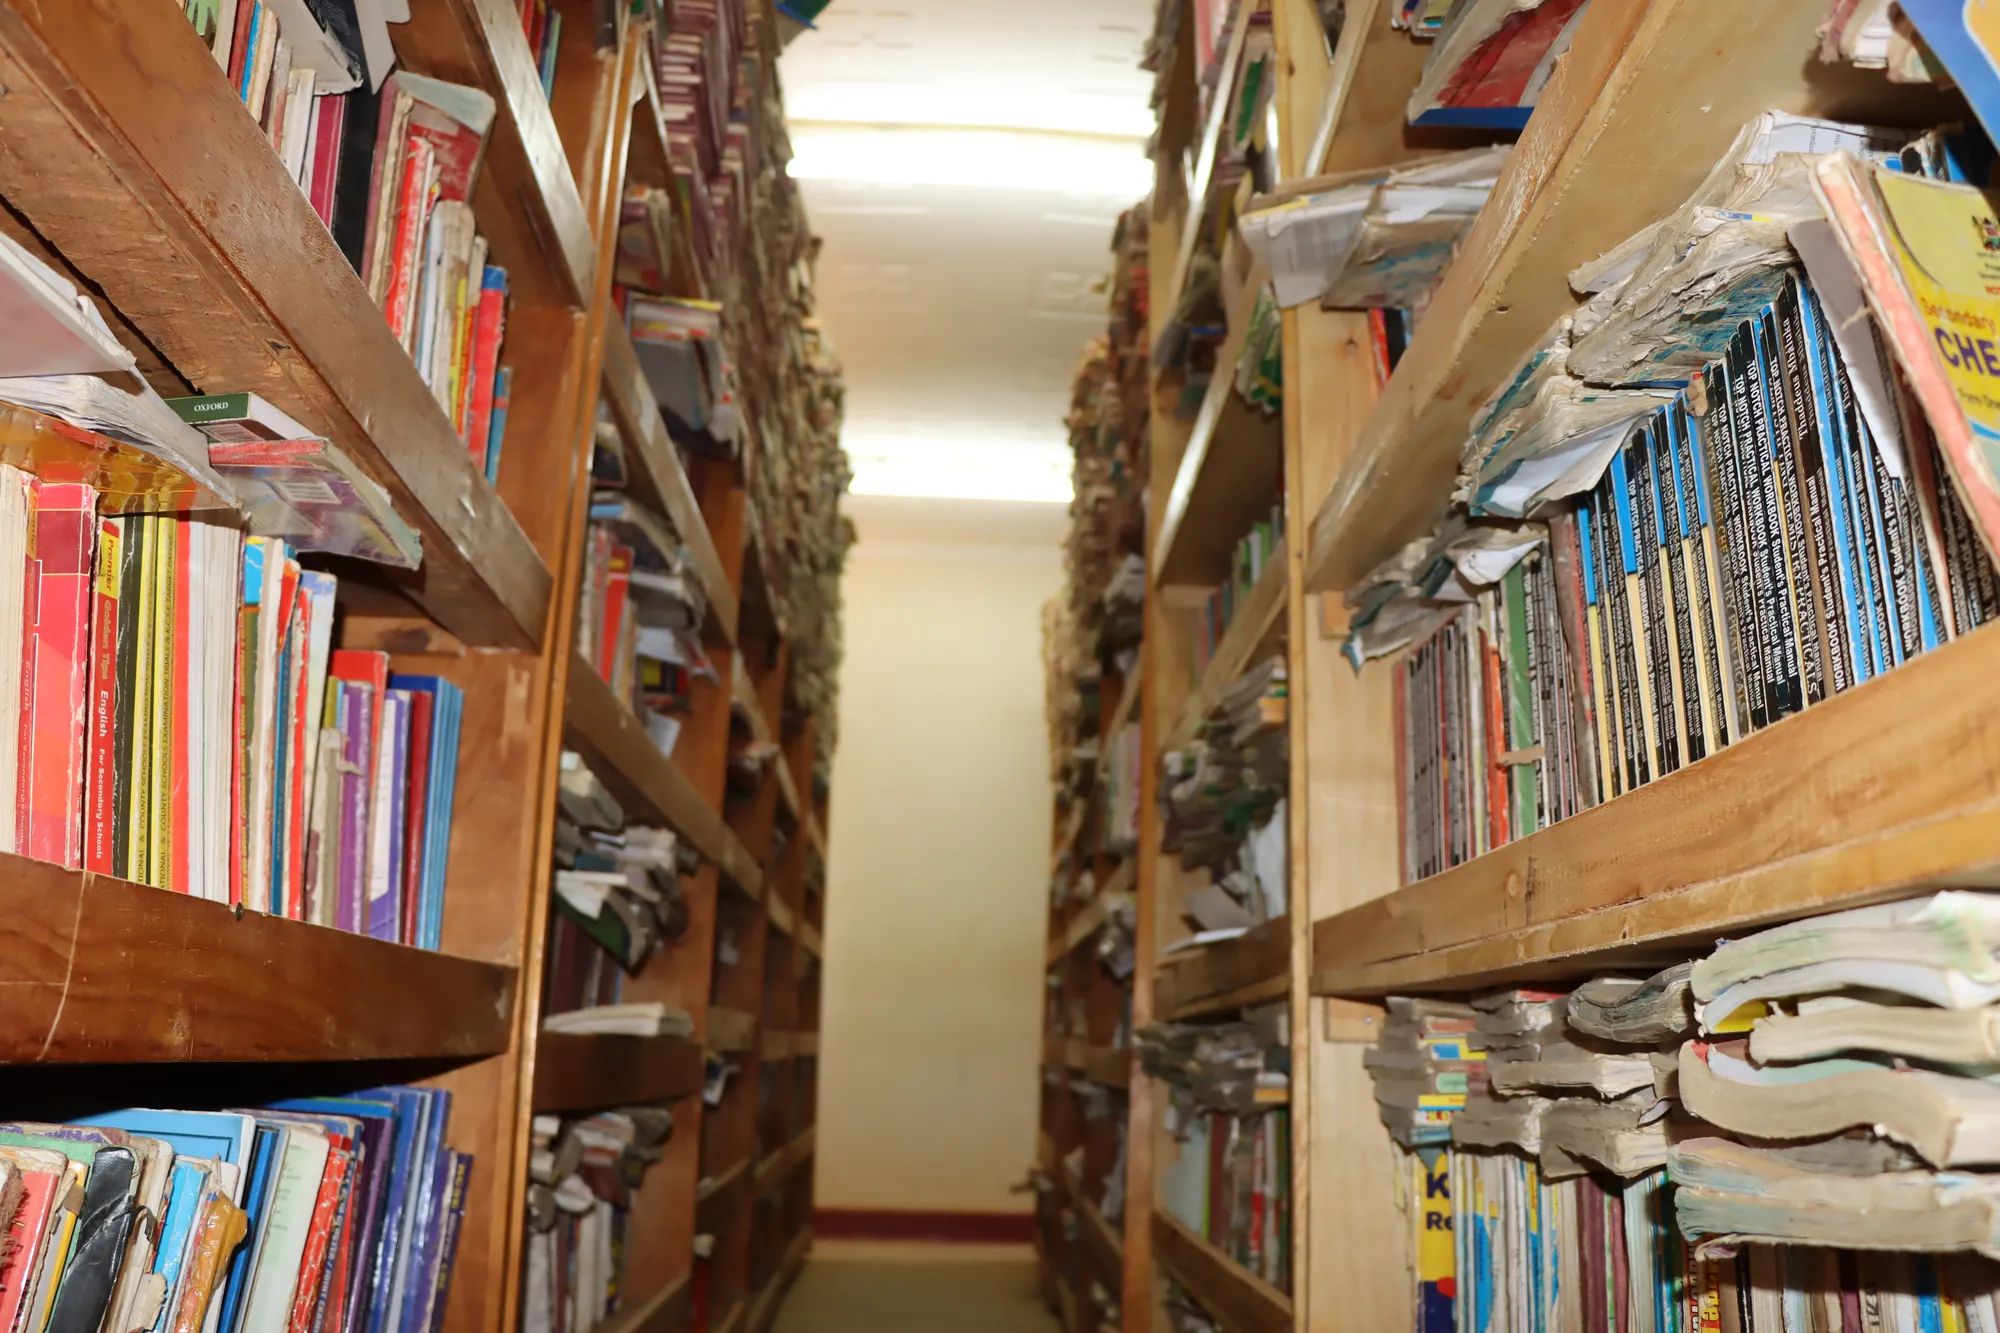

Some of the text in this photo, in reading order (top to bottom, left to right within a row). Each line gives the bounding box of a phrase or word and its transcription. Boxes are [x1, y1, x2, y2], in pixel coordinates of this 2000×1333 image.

[194, 401, 229, 418] OXFORD
[1792, 375, 1809, 441] Thaddeus
[1628, 478, 1636, 495] TOP
[1851, 450, 1863, 492] Manual
[1630, 496, 1638, 527] NOTCH
[1734, 374, 1784, 684] TOP NOTCH PRACTICAL WORKBOOK Student's Practical Manual
[1747, 359, 1797, 677] TOP NOTCH PRACTICAL WORKBOOK Student's Practical Manual
[1769, 356, 1822, 681] TOP NOTCH PRACTICAL WORKBOOK Student's Practical Manual
[1858, 493, 1871, 545] Practical
[105, 539, 114, 591] Premier
[1633, 528, 1643, 577] PRACTICAL
[1710, 407, 1756, 710] TOP NOTCH PRACTICAL WORKBOOK Student's Practical Manual
[1718, 402, 1763, 708] TOP NOTCH PRACTICAL WORKBOOK Student's Practical Manual
[1885, 519, 1903, 574] Student's
[1681, 437, 1724, 729] TOP NOTCH PRACTICAL WORKBOOK Student's Practical Manual
[1806, 475, 1844, 690] WORKBOOK Student's Practical Manual
[1867, 546, 1880, 601] Student's
[102, 599, 111, 648] Golden
[1896, 574, 1912, 652] WORKBOOK
[100, 653, 109, 678] Tips
[1758, 598, 1769, 644] Practical
[1764, 645, 1774, 683] Manual
[97, 690, 108, 736] English
[1623, 687, 1633, 727] Practical
[1647, 672, 1657, 714] Practical
[1626, 727, 1634, 759] Manual
[1651, 713, 1660, 747] Manual
[96, 767, 105, 818] Secondary
[95, 822, 103, 858] Schools
